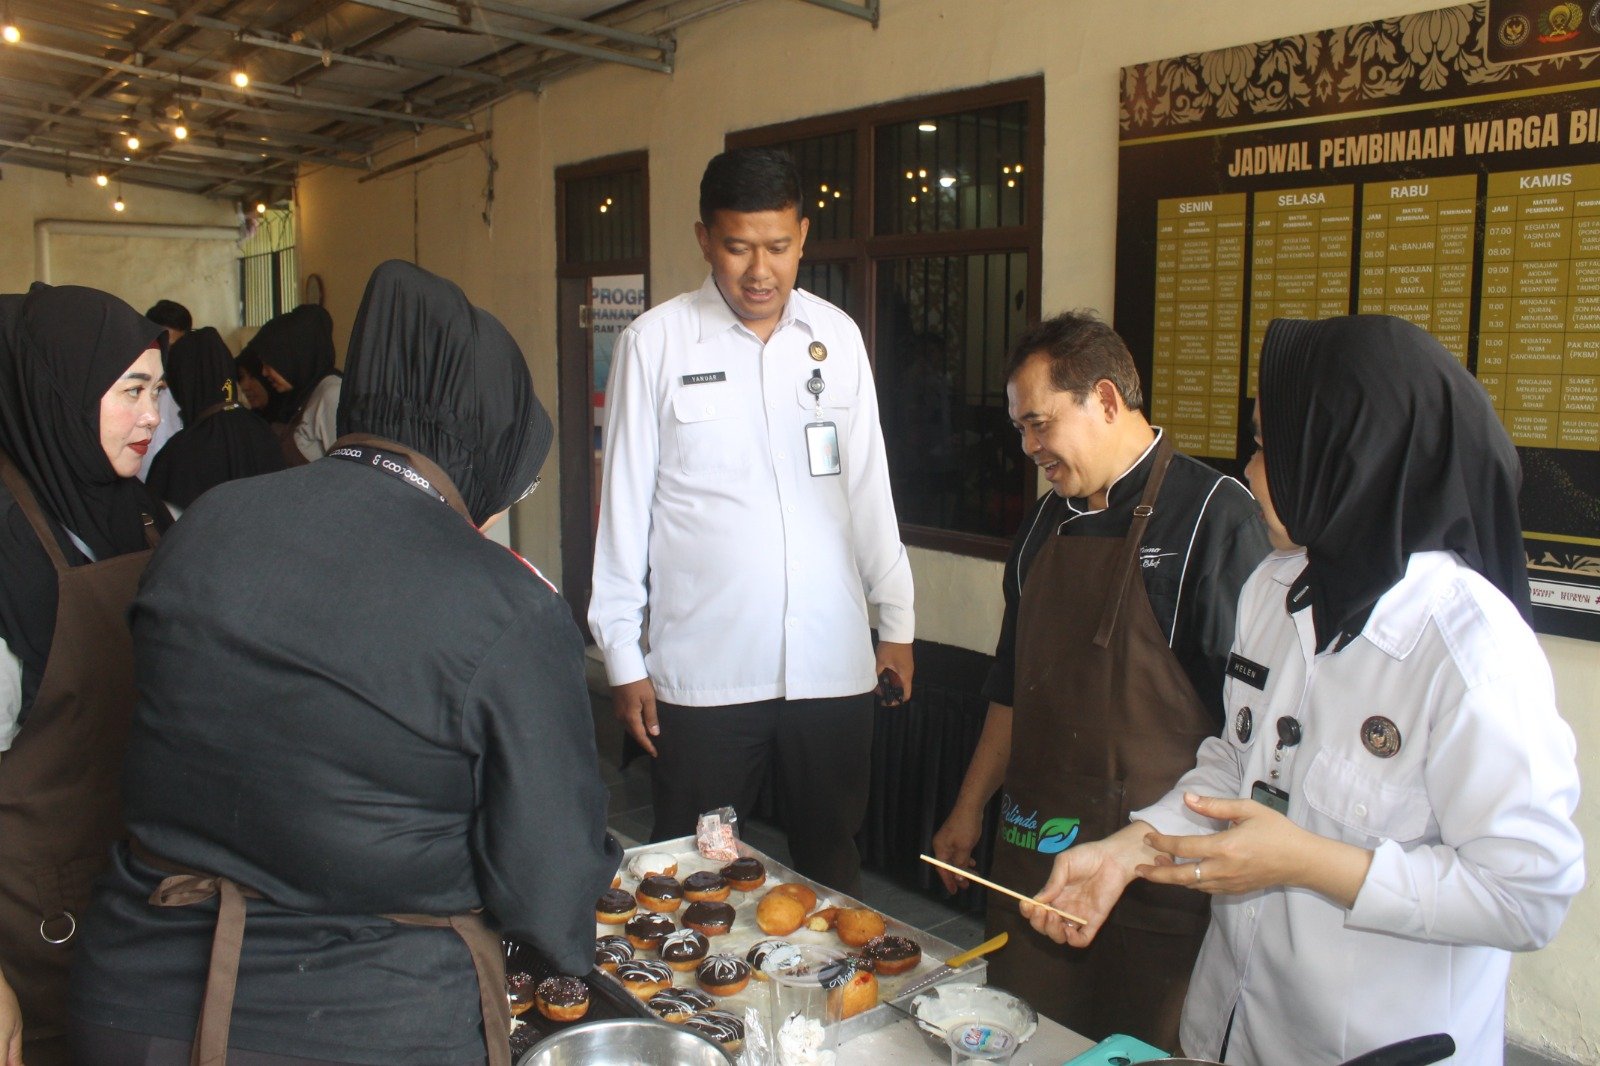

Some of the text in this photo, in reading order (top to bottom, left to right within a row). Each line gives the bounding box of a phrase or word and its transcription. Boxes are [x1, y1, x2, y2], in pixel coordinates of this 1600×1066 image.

[1229, 108, 1600, 177] JADWAL PEMBINAAN WARGA BI
[1520, 173, 1572, 189] KAMIS
[1391, 185, 1428, 198] RABU
[1278, 193, 1325, 206] SELASA
[1178, 201, 1212, 213] SENIN
[1390, 242, 1434, 250] AL-BANJARI
[1488, 248, 1511, 256] 08.00
[1570, 351, 1598, 359] (PKBM)
[1564, 394, 1598, 402] (TAMPING
[1234, 662, 1256, 678] HELEN
